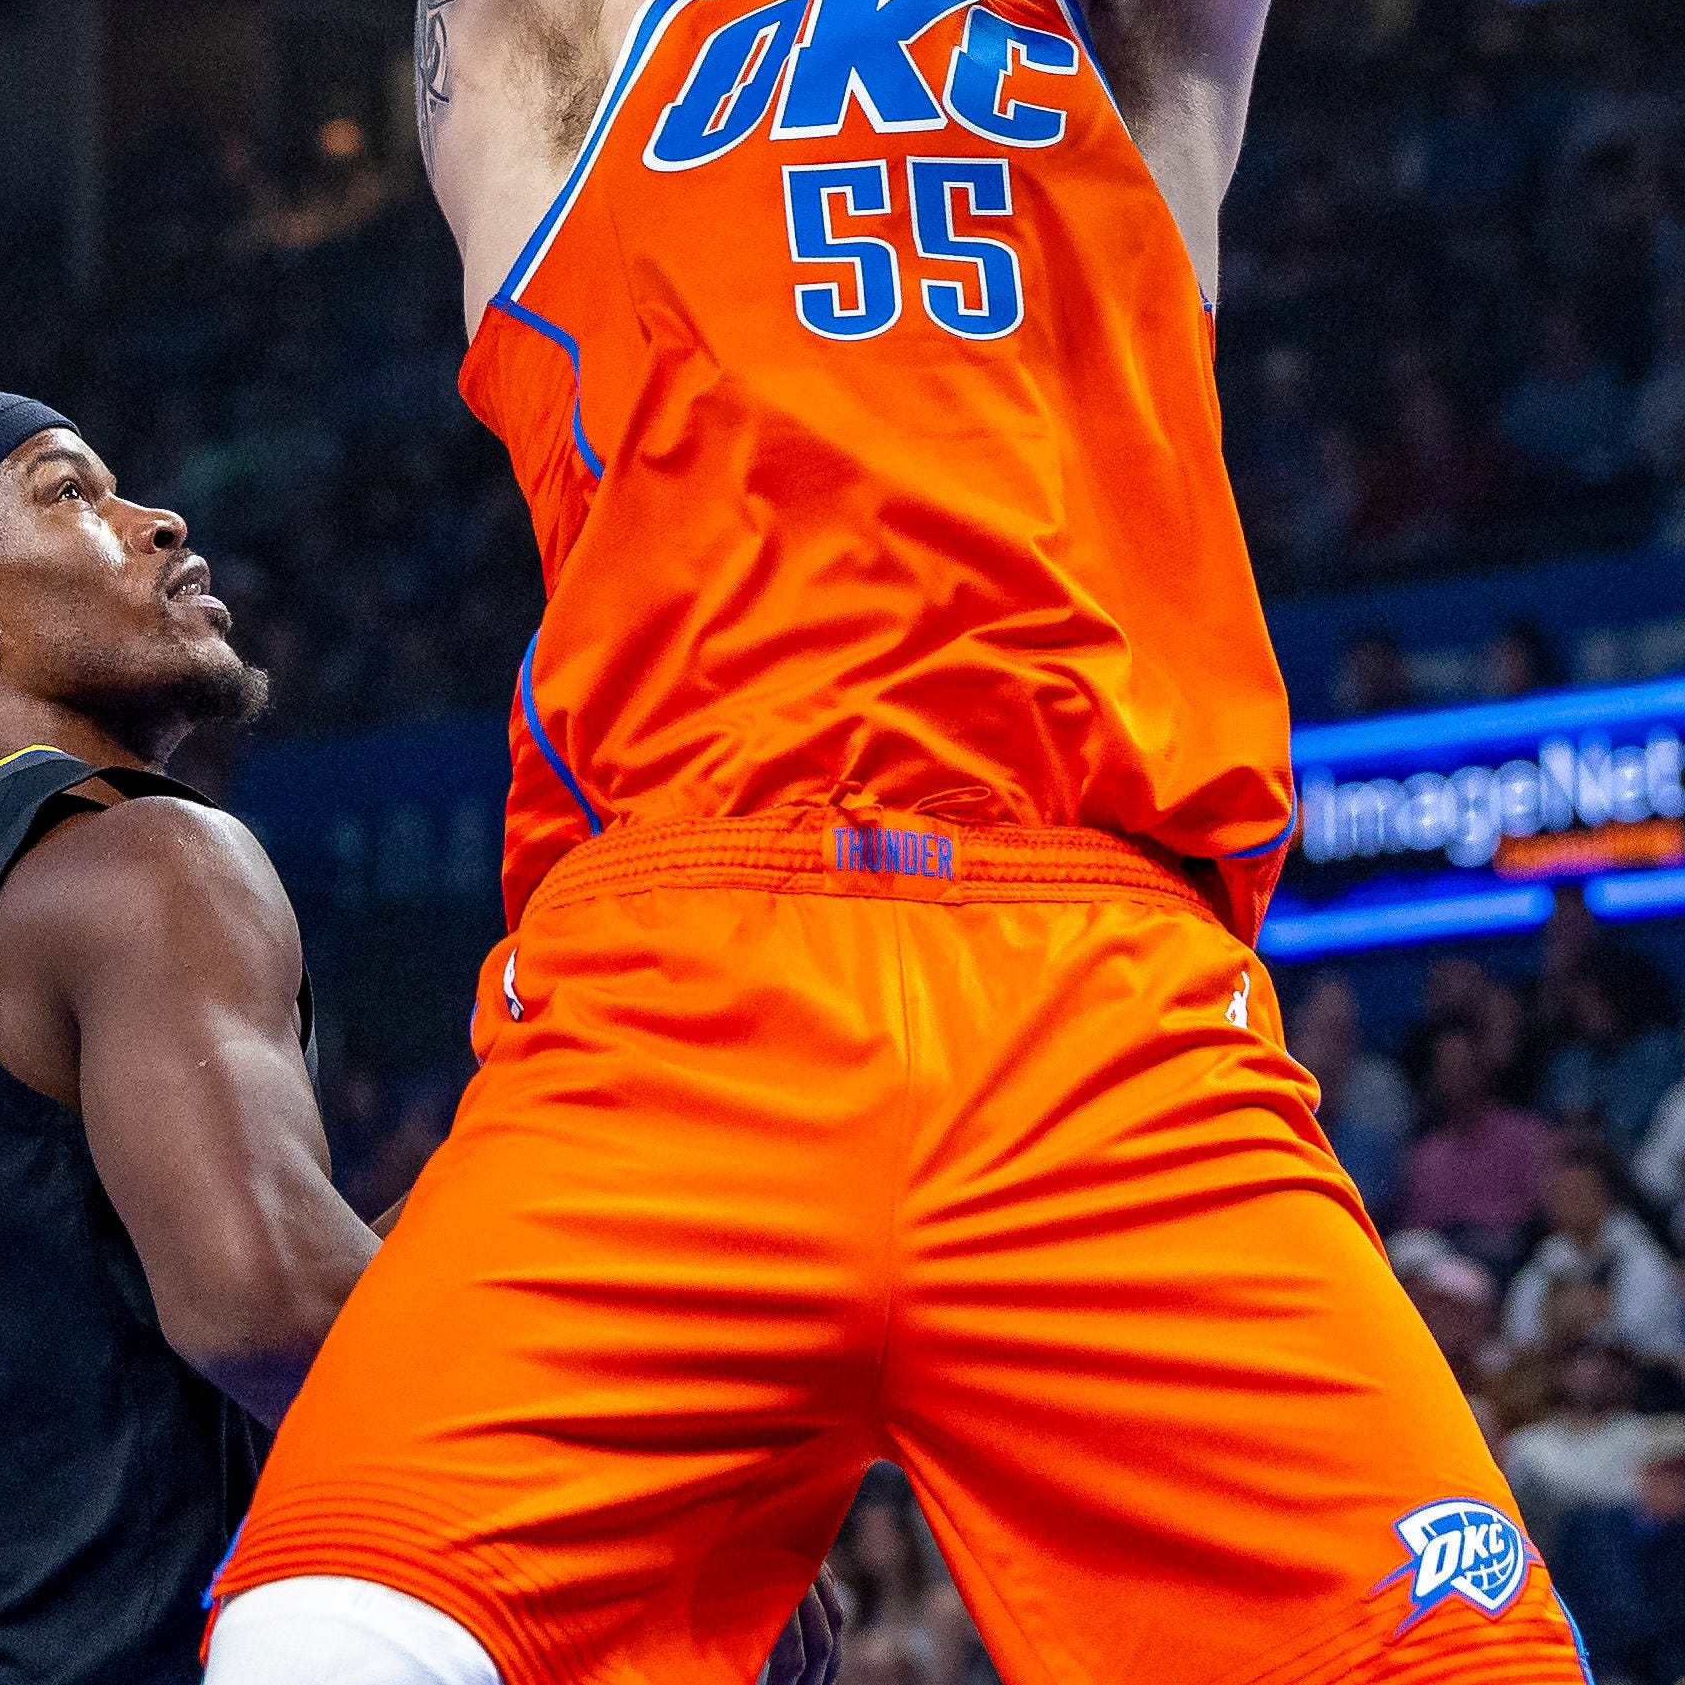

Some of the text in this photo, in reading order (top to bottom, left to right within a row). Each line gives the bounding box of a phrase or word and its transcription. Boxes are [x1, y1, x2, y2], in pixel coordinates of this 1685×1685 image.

[781, 156, 1025, 341] 55
[832, 826, 954, 881] THUNDER
[1415, 1520, 1506, 1598] OKC
